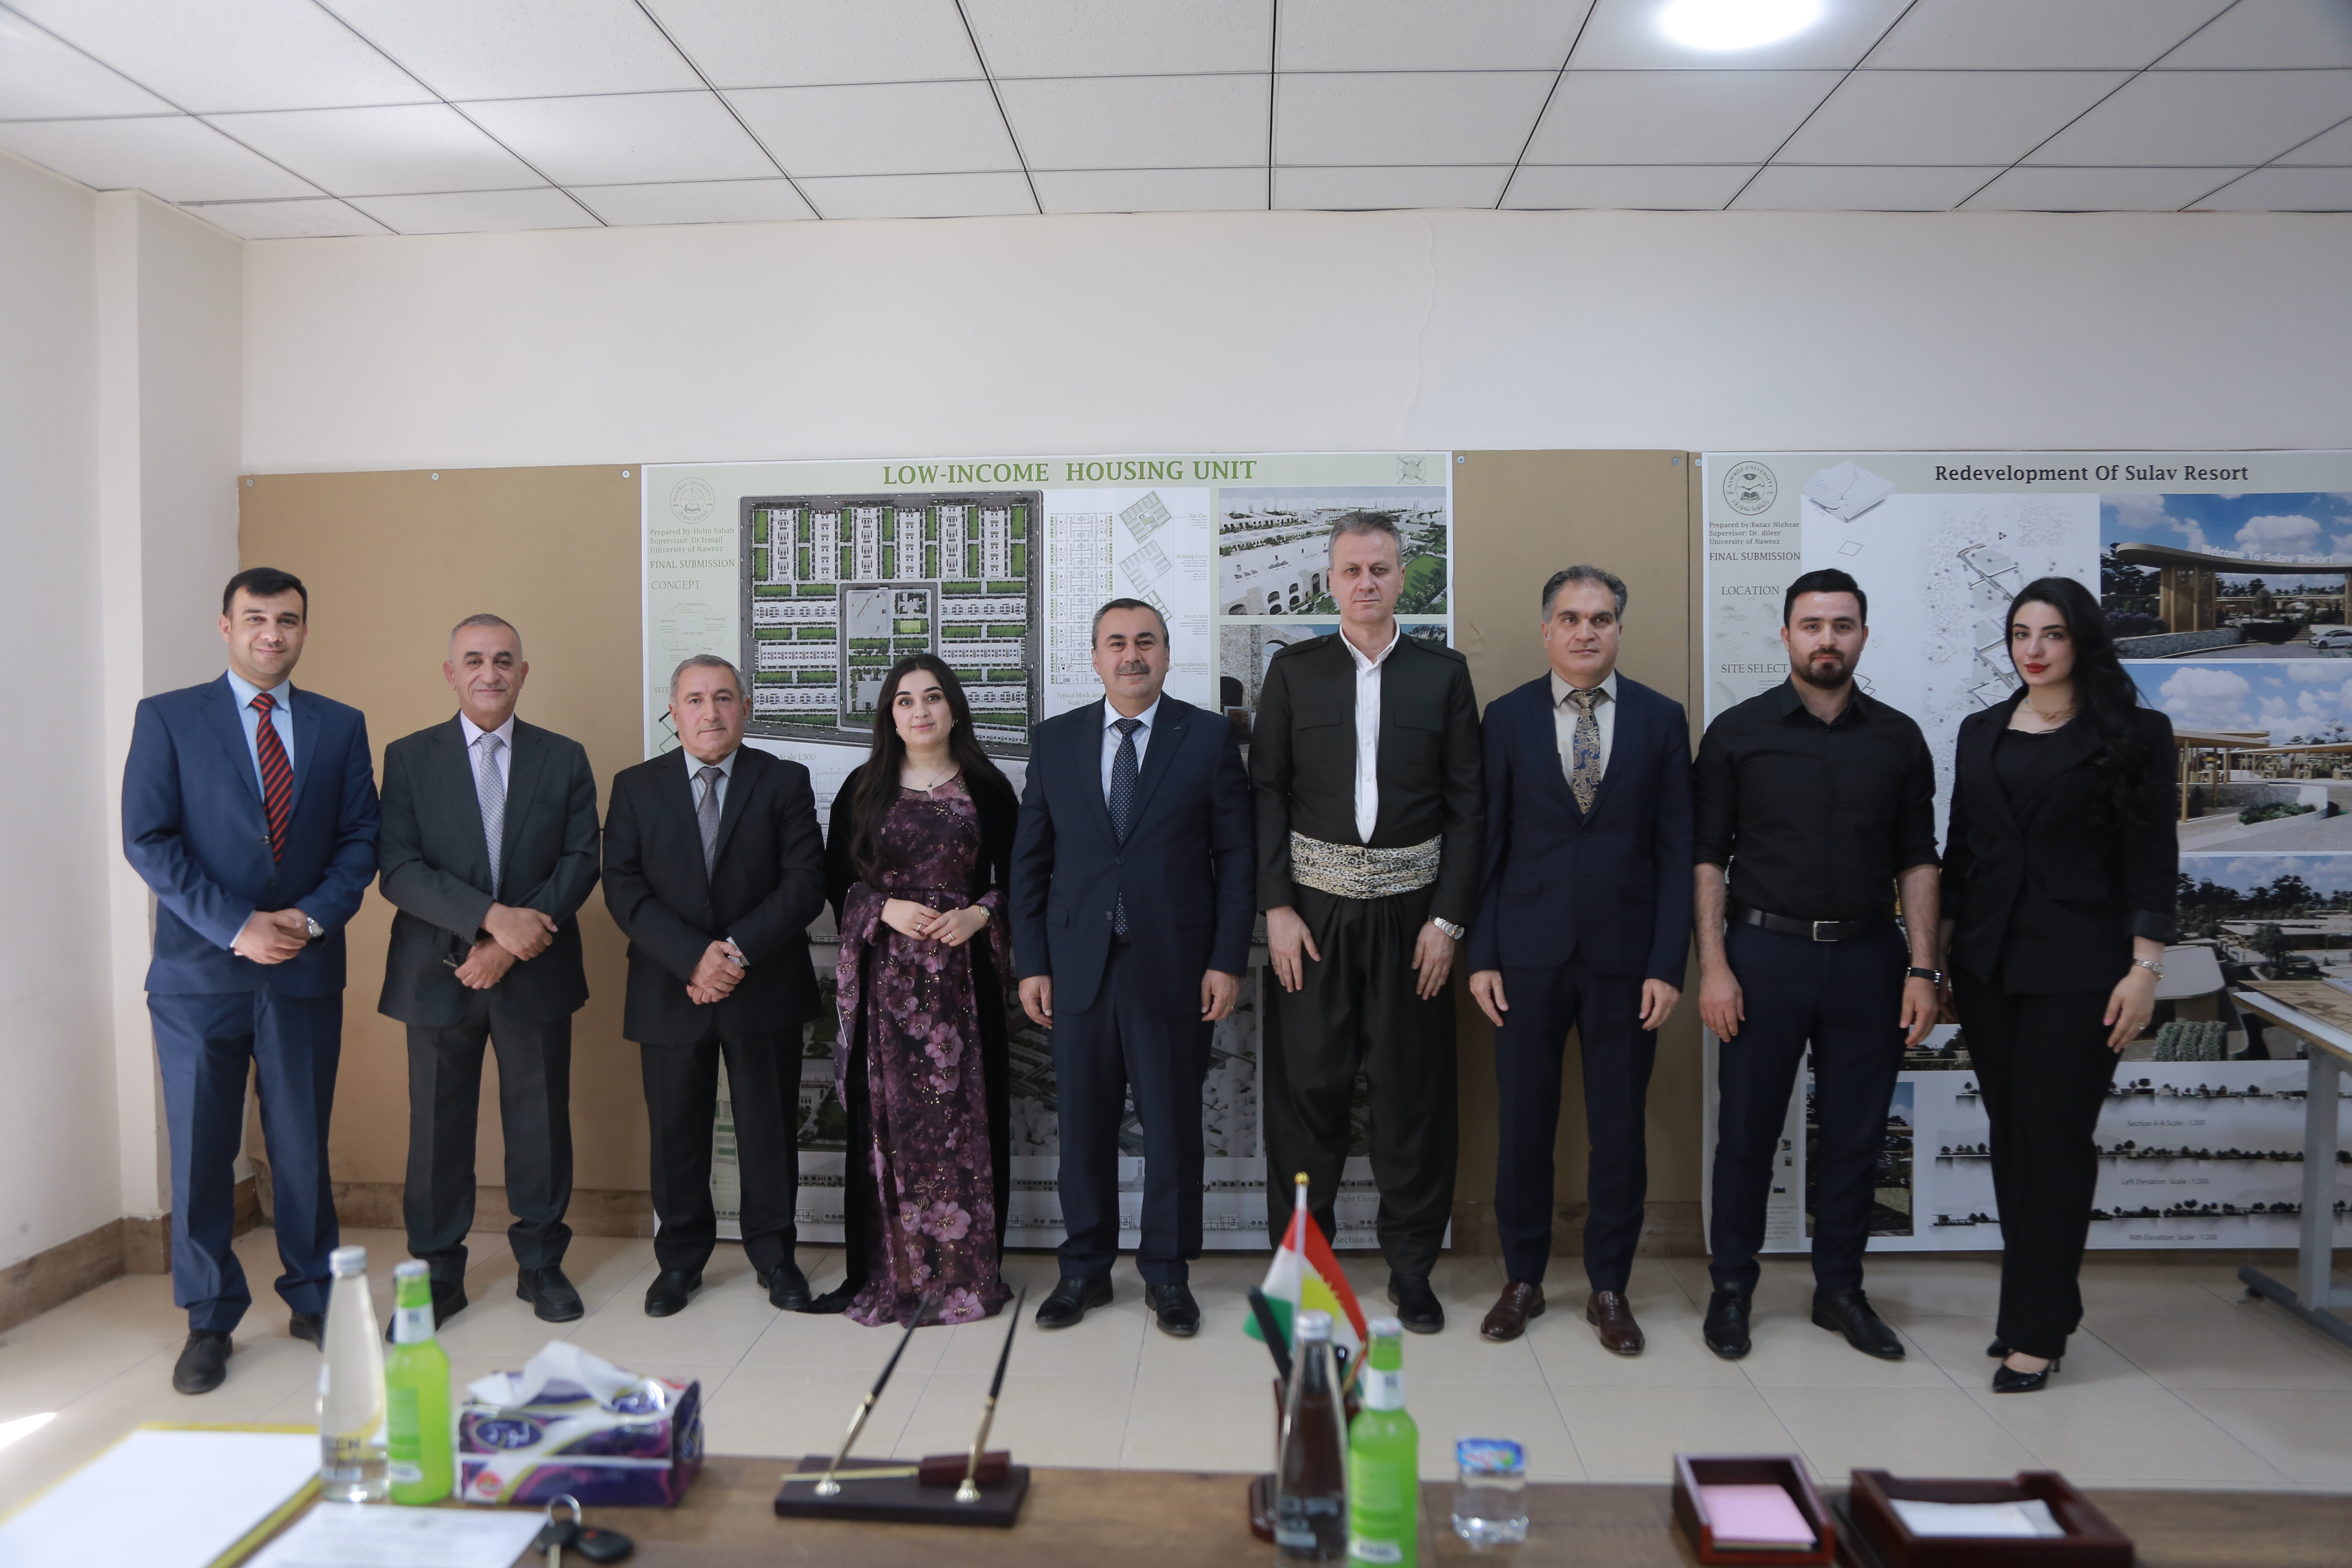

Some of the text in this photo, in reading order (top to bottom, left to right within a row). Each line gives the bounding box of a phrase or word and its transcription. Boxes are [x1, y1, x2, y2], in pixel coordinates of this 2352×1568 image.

[883, 460, 1257, 486] LOW-INCOME HOUSING UNIT
[1727, 466, 1773, 488] NAWROZ UNIVERSITY
[1935, 465, 2249, 483] Redevelopment Of Sulav Resort
[1709, 522, 1739, 530] Prepared
[1709, 552, 1801, 561] FINAL SUBMISSION
[2201, 544, 2334, 563] Welcome To Sulav Resort
[650, 559, 735, 569] FINAL SUBMISSION
[651, 580, 701, 590] CONCEPT
[1721, 586, 1780, 595] LOCATION
[1721, 664, 1745, 673] SITE
[1336, 1194, 1355, 1203] Right
